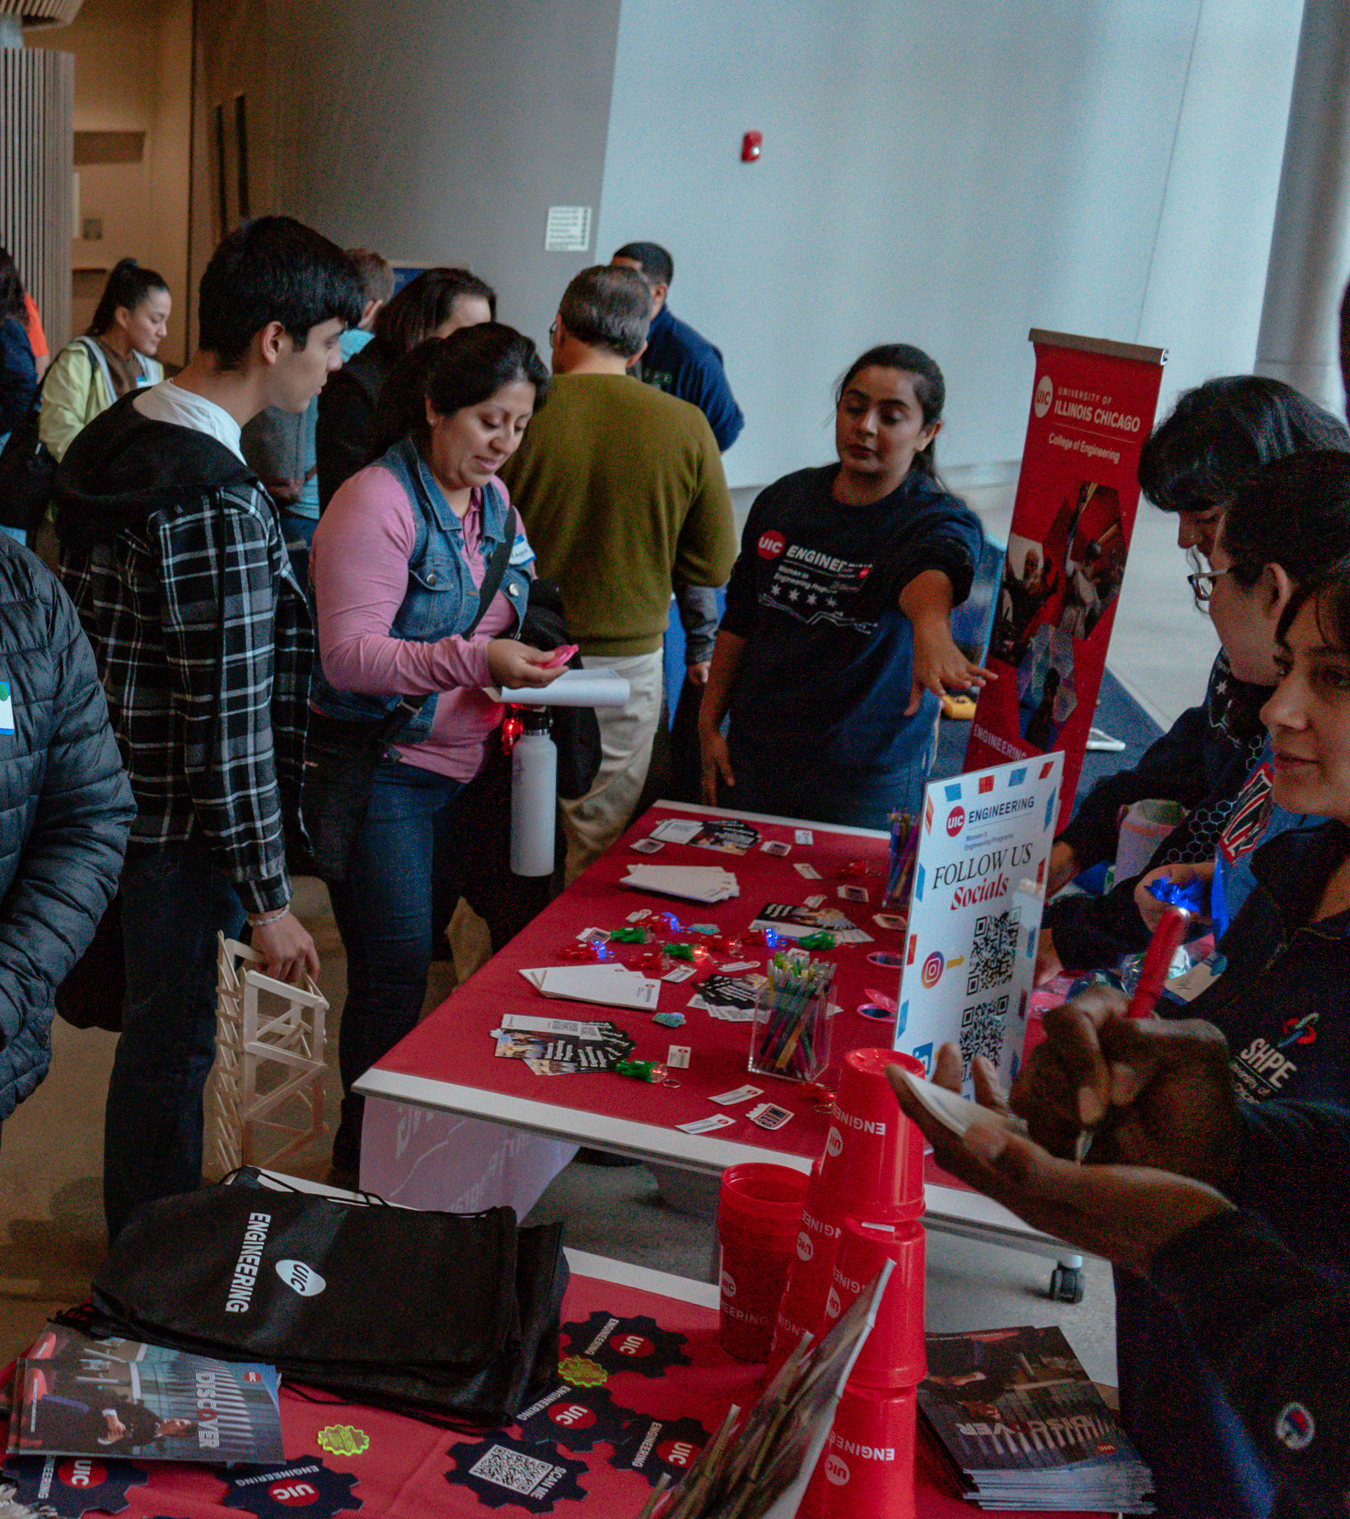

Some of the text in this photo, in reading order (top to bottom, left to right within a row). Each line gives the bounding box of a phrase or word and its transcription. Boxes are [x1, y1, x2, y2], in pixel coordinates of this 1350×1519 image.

[1057, 386, 1112, 406] UNIVERSITY OF
[1054, 400, 1141, 433] ILLINOIS CHICAGO
[1048, 432, 1120, 464] College of Engineering
[758, 536, 783, 554] UIC
[973, 723, 1028, 761] ENGINEERING
[947, 796, 1035, 830] UIC ENGINEERING
[932, 842, 1034, 890] FOLLOW US
[950, 872, 1010, 911] Socials
[1240, 1038, 1298, 1088] SHPE
[225, 1212, 272, 1314] ENGINEERING
[290, 1264, 310, 1292] UIC
[584, 1318, 620, 1356] ENGINEERING
[619, 1335, 644, 1354] UIC
[196, 1372, 220, 1448] DISCOVER
[516, 1385, 572, 1422] ENGINEERING
[555, 1405, 589, 1425] UIC
[631, 1422, 663, 1468] ENGINEERING
[668, 1442, 693, 1466] UIC
[71, 1459, 92, 1486] UIC
[234, 1464, 320, 1487] ENGINEERING
[530, 1466, 568, 1500] SCAN ME
[826, 1460, 848, 1480] UIC
[272, 1484, 315, 1500] UIC
